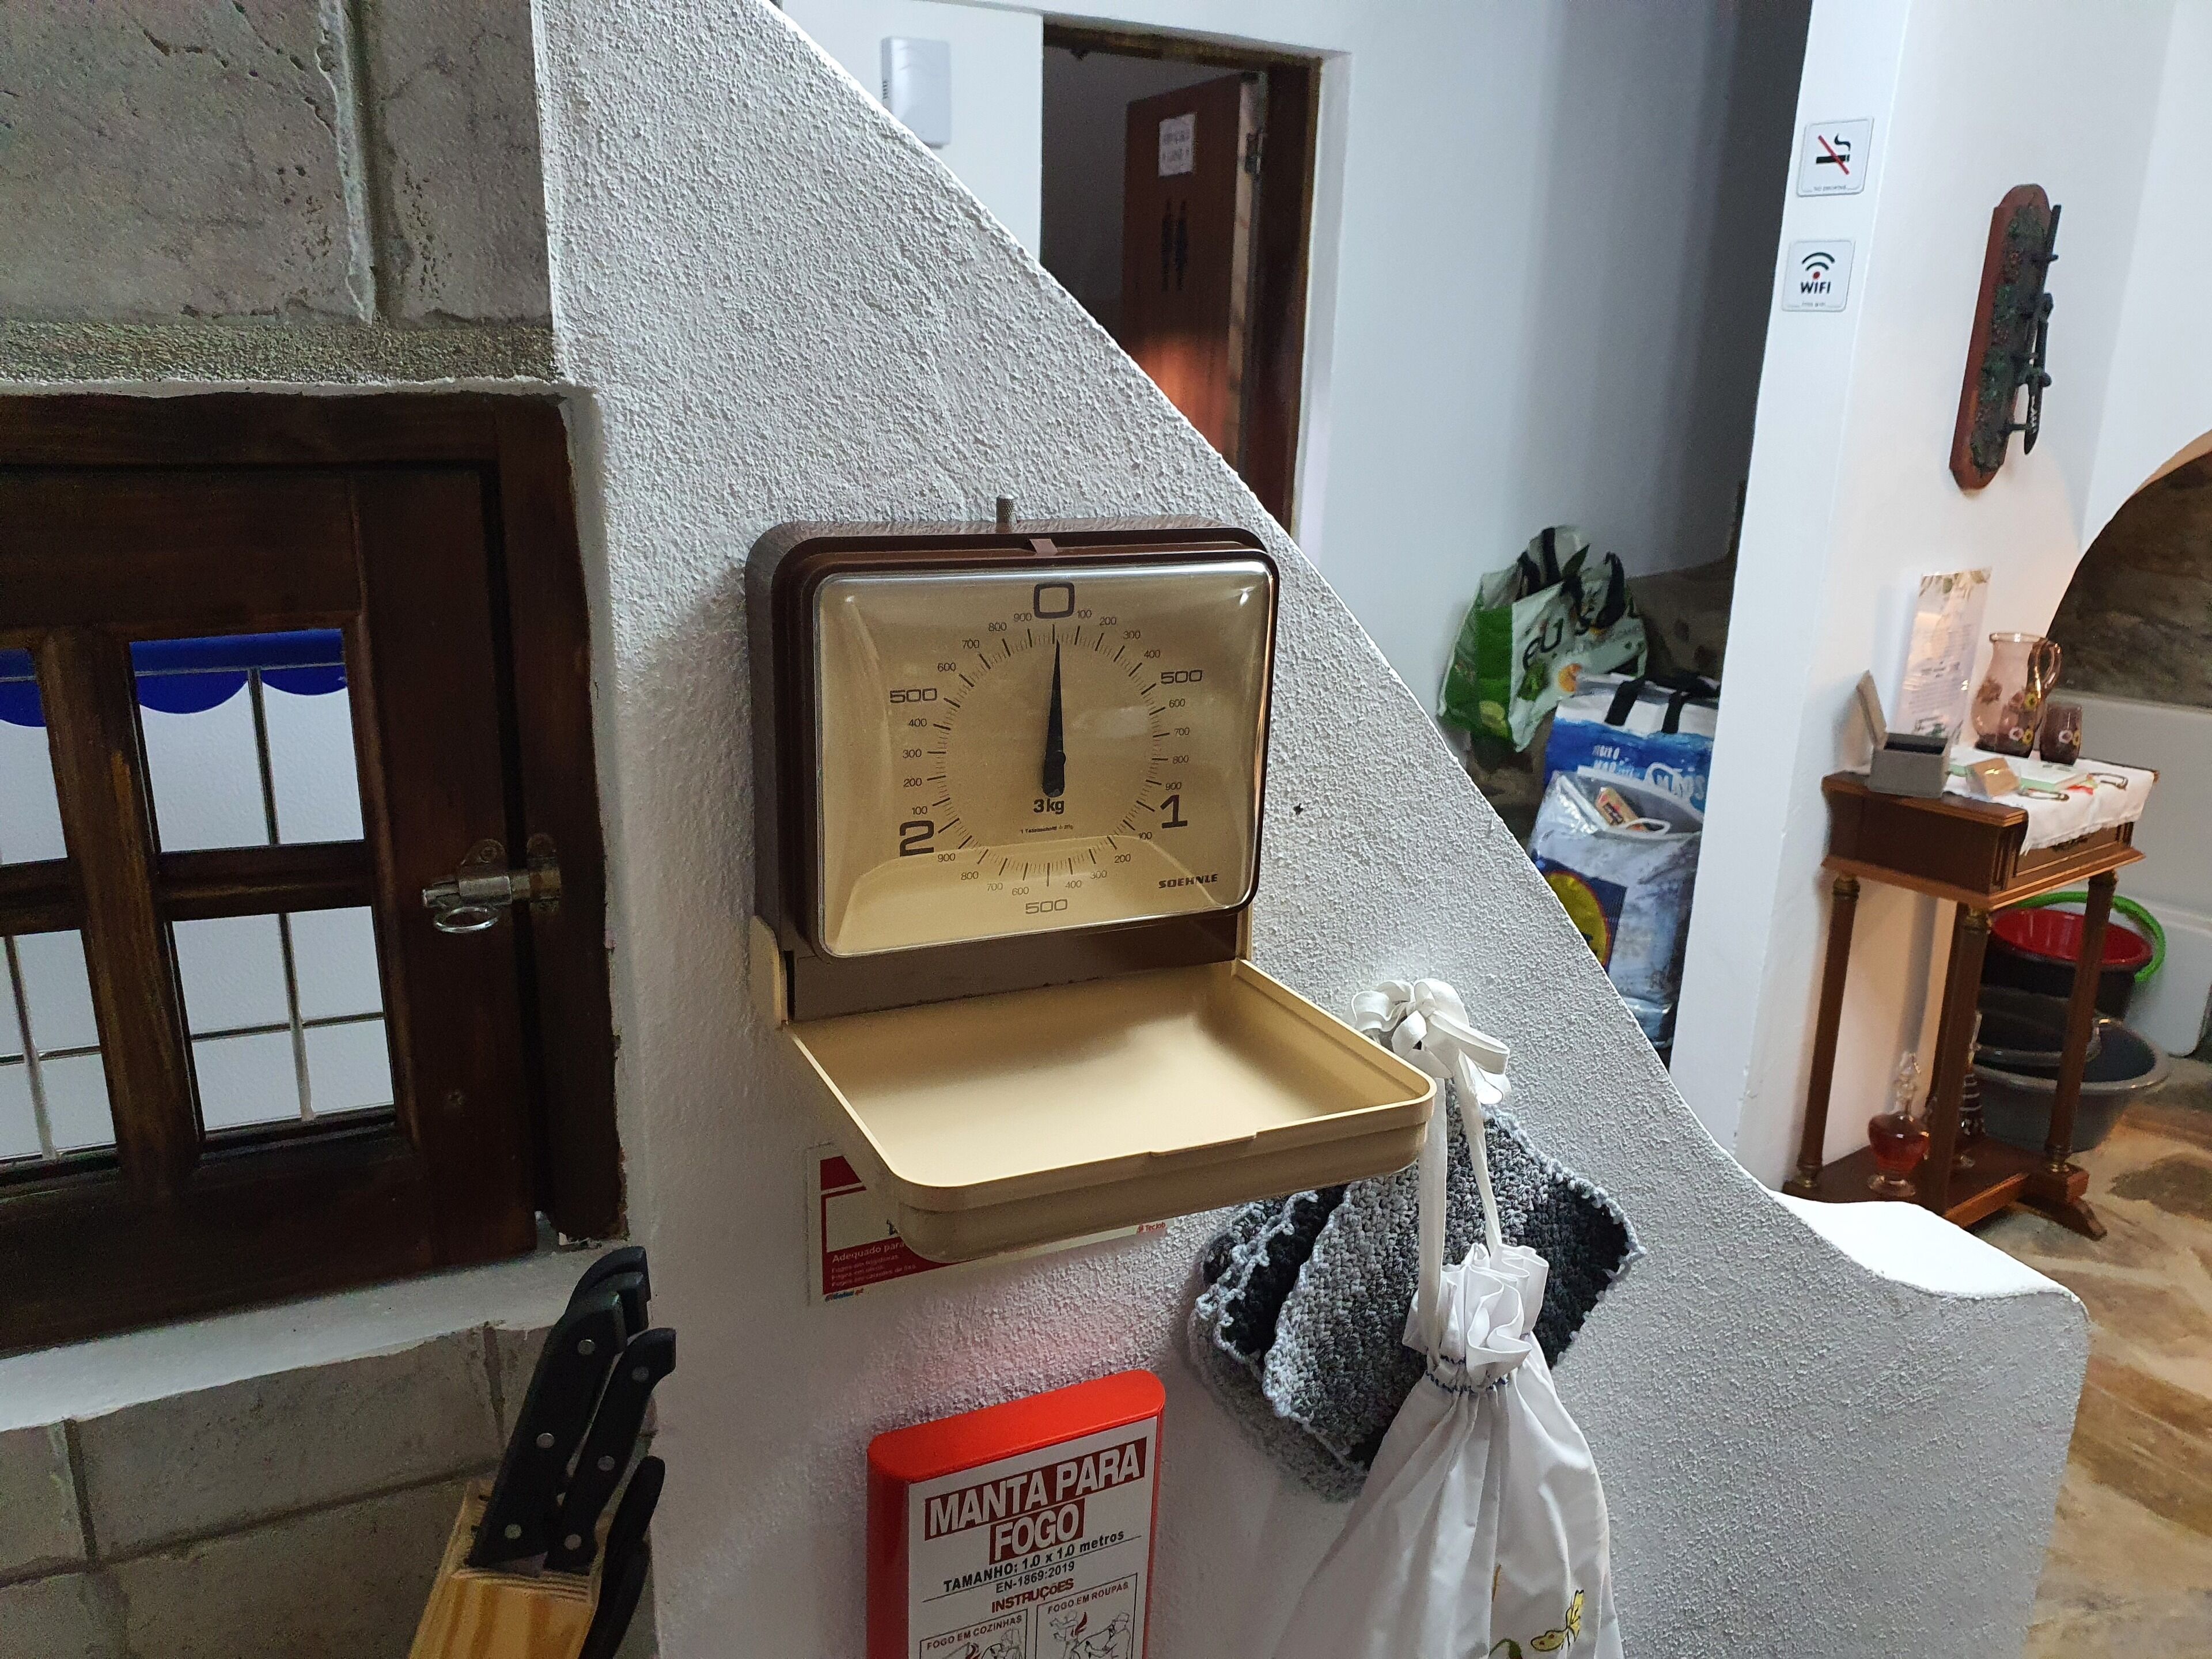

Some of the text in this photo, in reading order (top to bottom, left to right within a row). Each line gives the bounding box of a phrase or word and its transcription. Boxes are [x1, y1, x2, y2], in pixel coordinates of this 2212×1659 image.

[1801, 281, 1831, 294] WIFI
[1033, 583, 1074, 618] 0
[1014, 613, 1032, 622] 900
[1077, 610, 1092, 618] 100
[1100, 616, 1116, 626] 200
[988, 622, 1007, 631] 800
[1123, 631, 1140, 639] 300
[963, 639, 979, 649] 700
[1144, 650, 1160, 658] 400
[938, 662, 956, 672] 600
[1161, 670, 1203, 684] 500
[890, 688, 937, 703] 500
[1169, 699, 1185, 708] 600
[908, 718, 927, 727] 400
[1175, 728, 1190, 736] 700
[903, 749, 922, 758] 300
[1173, 755, 1189, 764] 800
[904, 778, 922, 787] 200
[1166, 782, 1181, 790] 900
[912, 806, 927, 815] 100
[1046, 798, 1065, 815] kg
[1160, 795, 1187, 828] 1
[900, 820, 934, 857] 2
[938, 853, 955, 862] 900
[1115, 854, 1131, 863] 200
[961, 871, 978, 880] 800
[1090, 870, 1107, 879] 300
[1065, 880, 1082, 888] 400
[1158, 873, 1218, 889] SOEHNLE
[988, 883, 1003, 891] 700
[1012, 887, 1029, 895] 600
[1026, 899, 1067, 914] 500
[832, 1246, 881, 1263] Adequado
[930, 1444, 1141, 1537] MANTA PARA
[994, 1503, 1080, 1562] FOGO
[944, 1530, 1124, 1593] TAMANHO: 1.0 x 1.0 metros
[996, 1560, 1074, 1593] EN-1869:2019
[1048, 1581, 1129, 1614] FOGO EM ROUPAS
[927, 1615, 1022, 1650] FOGO EM COZINHAS
